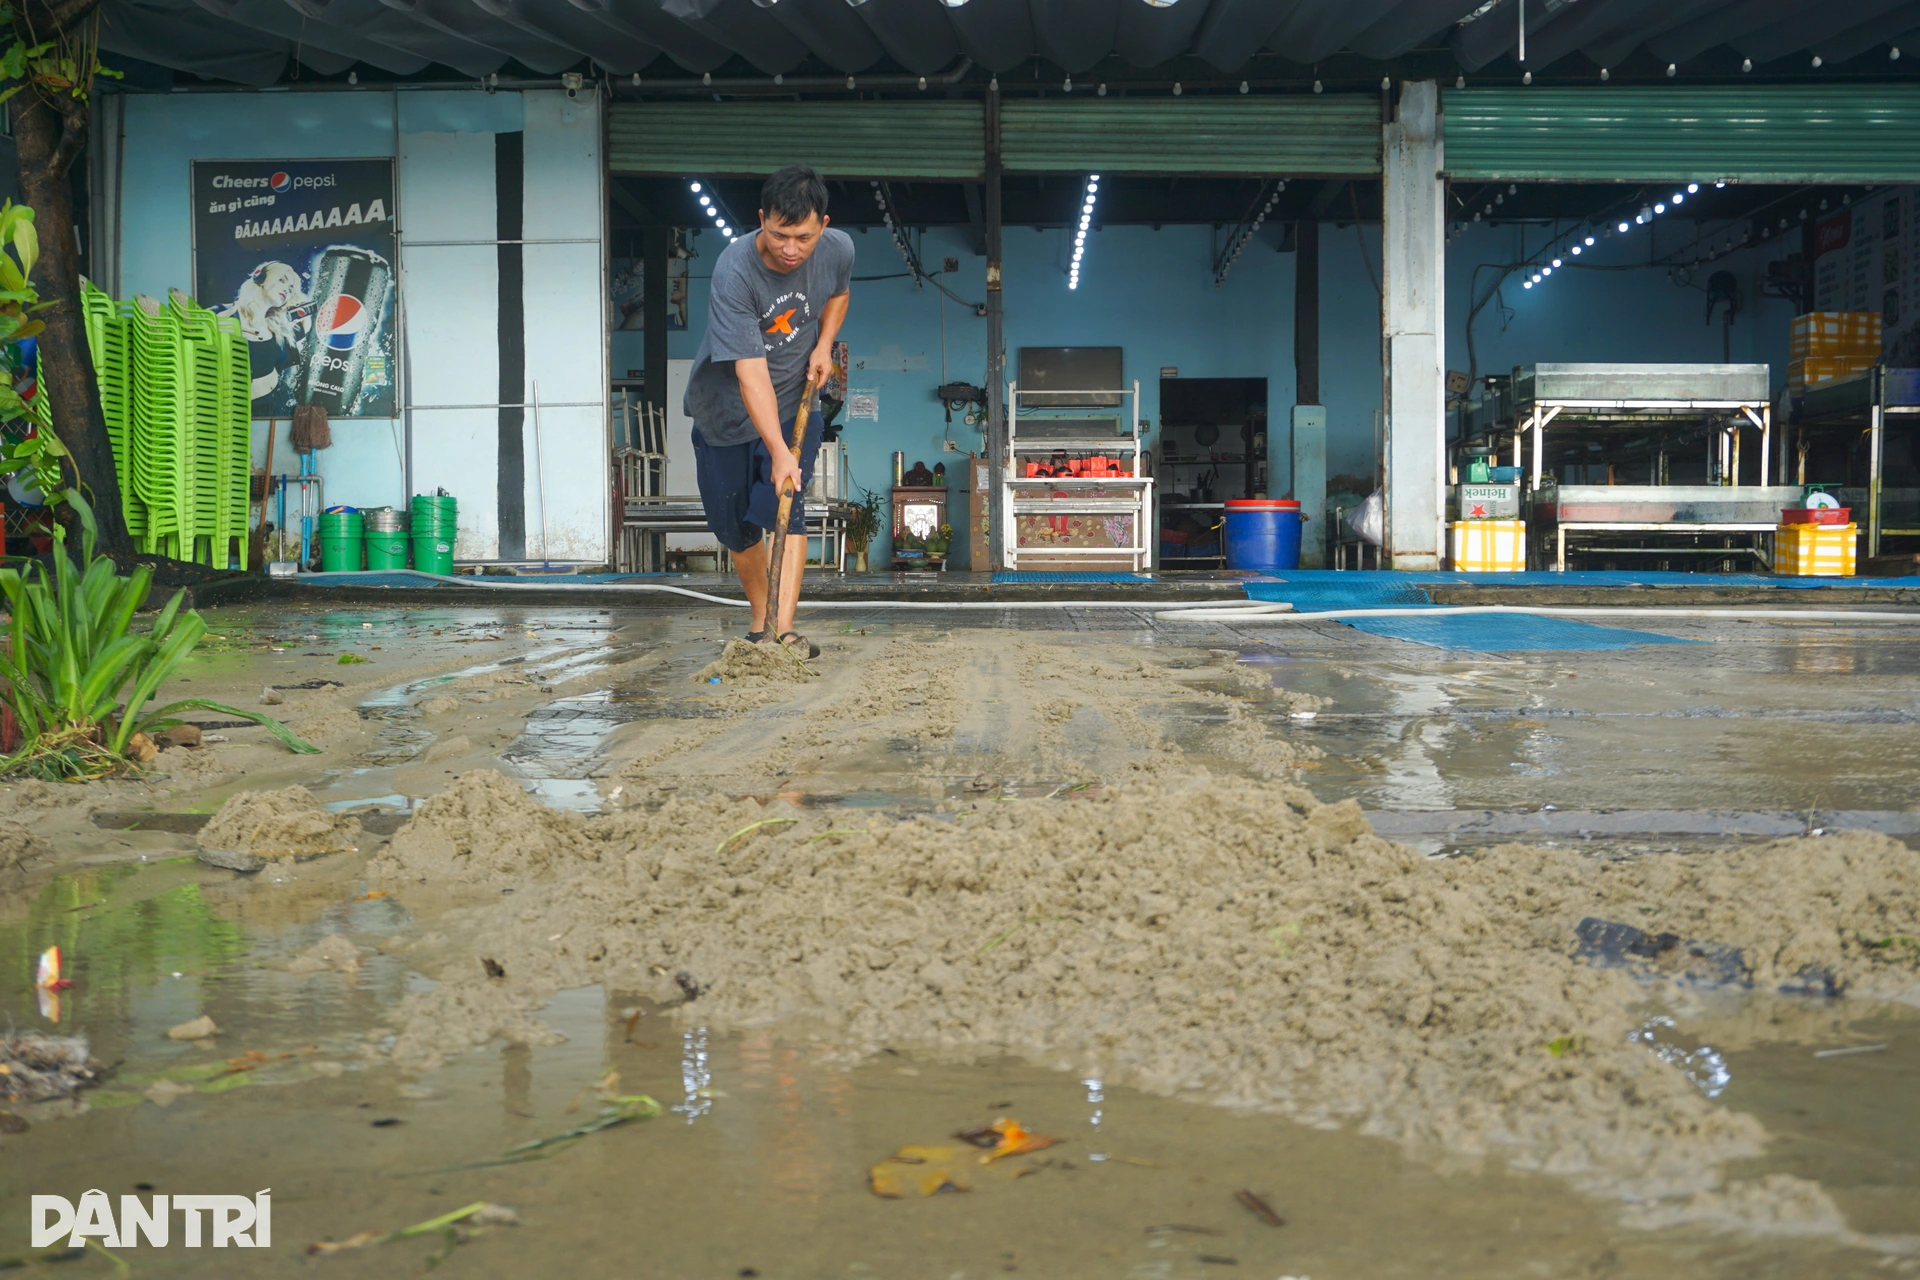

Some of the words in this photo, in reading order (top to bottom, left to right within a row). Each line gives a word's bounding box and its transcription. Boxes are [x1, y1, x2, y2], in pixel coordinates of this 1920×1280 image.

[212, 175, 269, 189] Cheers
[293, 174, 335, 190] pepsi
[209, 201, 226, 213] ăn
[228, 198, 242, 213] gì
[243, 194, 276, 208] cũng
[776, 291, 793, 305] DEPT
[785, 326, 800, 343] WORK
[309, 354, 354, 373] pepsi
[330, 384, 345, 393] CALO
[1465, 488, 1507, 499] Heinek
